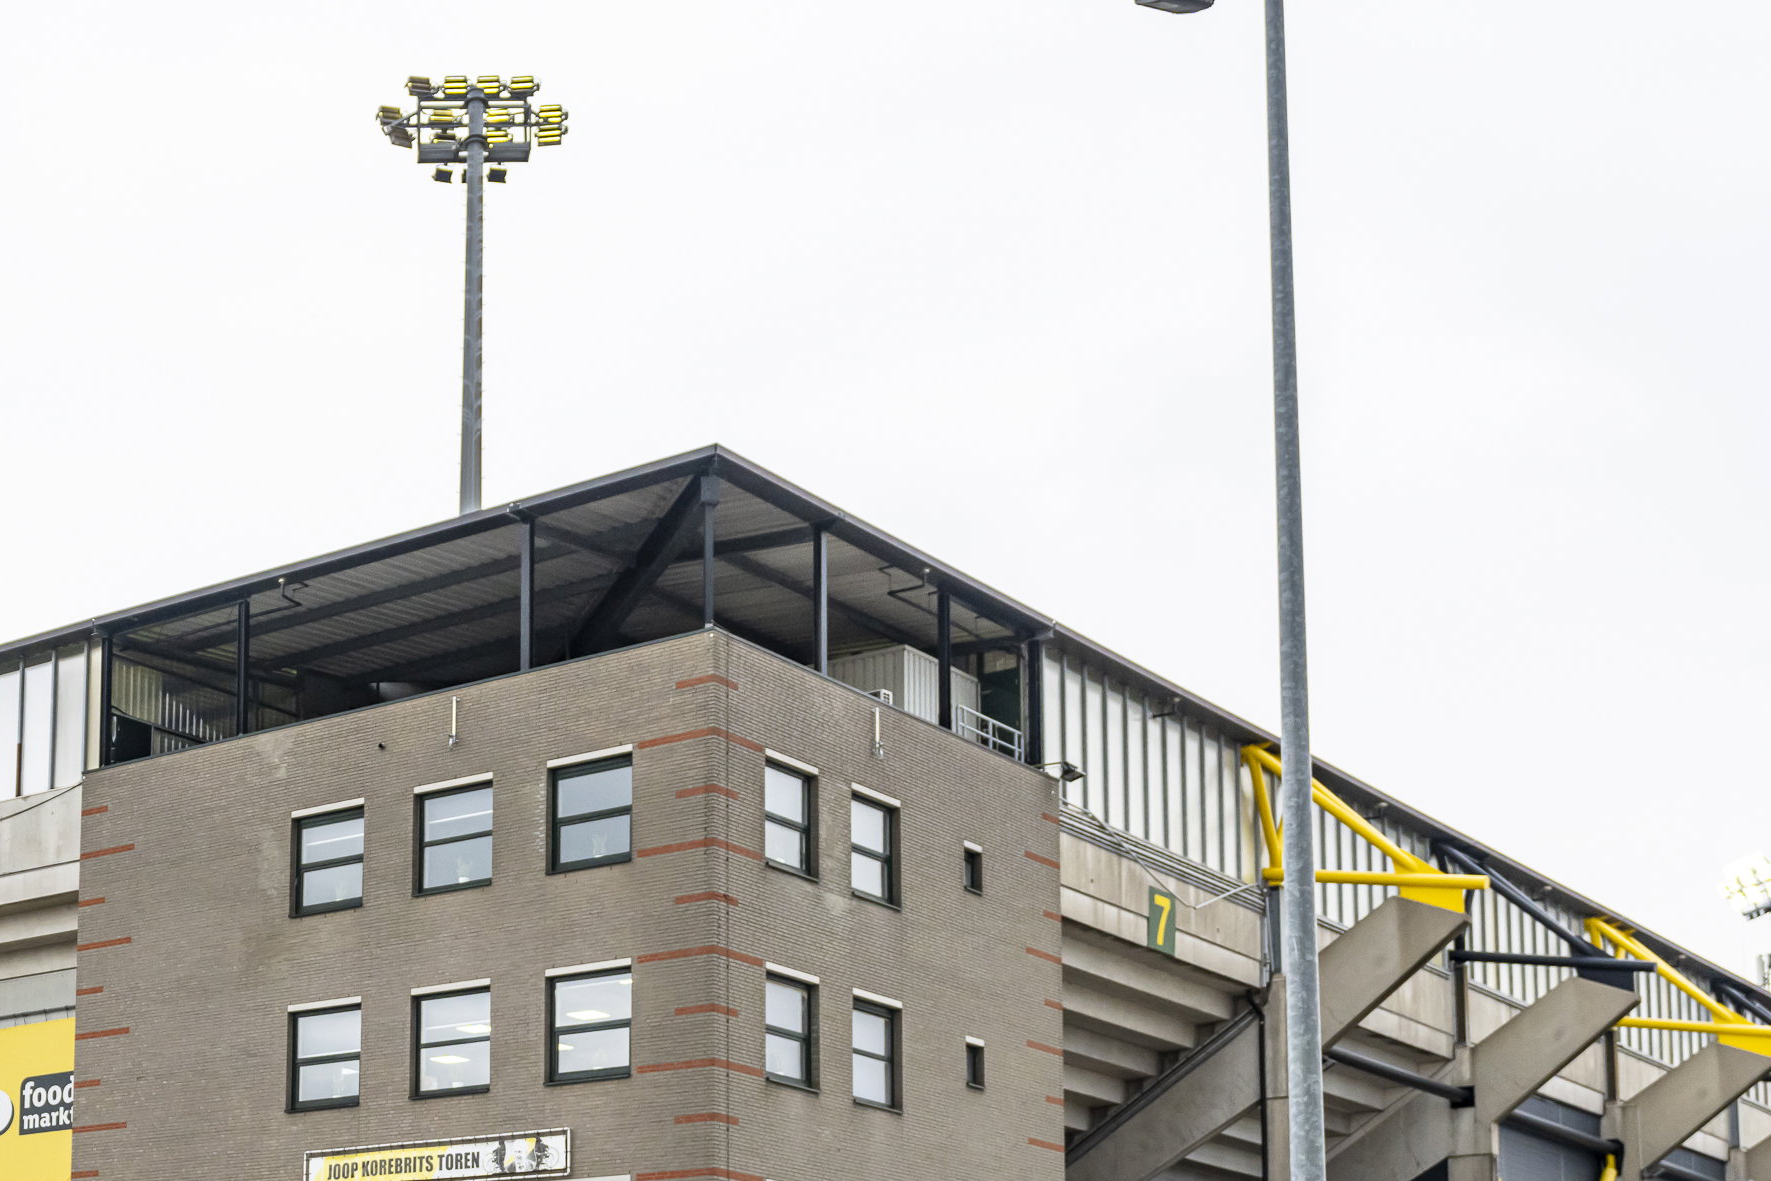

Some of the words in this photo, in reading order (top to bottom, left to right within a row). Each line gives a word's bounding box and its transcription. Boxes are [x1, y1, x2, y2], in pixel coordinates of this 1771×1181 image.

[1153, 893, 1171, 946] 7
[327, 1162, 359, 1181] JOOP
[361, 1155, 434, 1178] KOREBRITS
[437, 1151, 481, 1171] TOREN
